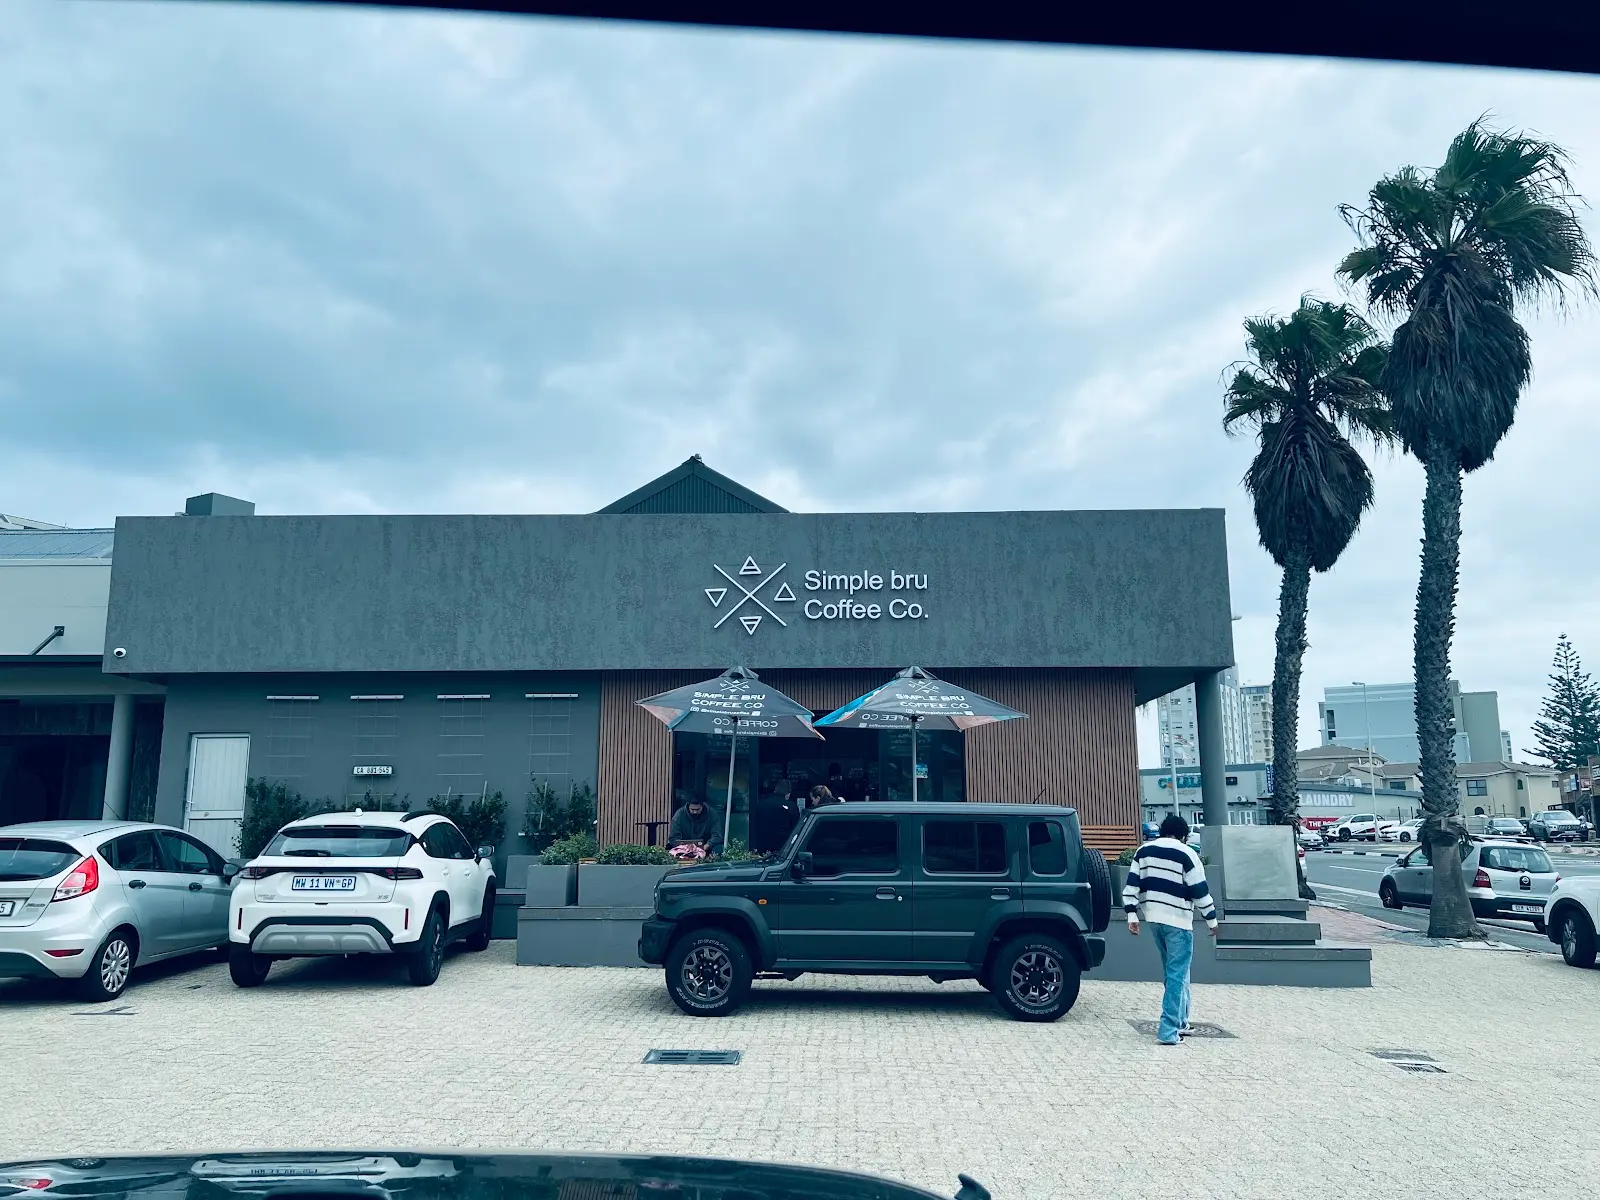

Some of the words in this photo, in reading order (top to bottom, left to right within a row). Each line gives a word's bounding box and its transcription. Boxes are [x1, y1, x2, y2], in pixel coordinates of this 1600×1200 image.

[804, 570, 884, 595] Simple
[891, 569, 928, 590] bru
[804, 599, 882, 619] Coffee
[889, 598, 929, 619] Co.
[693, 691, 740, 701] SIMPLE
[895, 693, 940, 701] SIMPLE
[691, 698, 743, 709] COFFEE
[900, 701, 950, 709] COFFEE
[1299, 793, 1354, 807] LAUNDRY
[1308, 820, 1322, 828] THE
[294, 878, 307, 889] MW
[309, 878, 320, 889] 11
[324, 878, 336, 889] VN
[341, 878, 354, 889] GP
